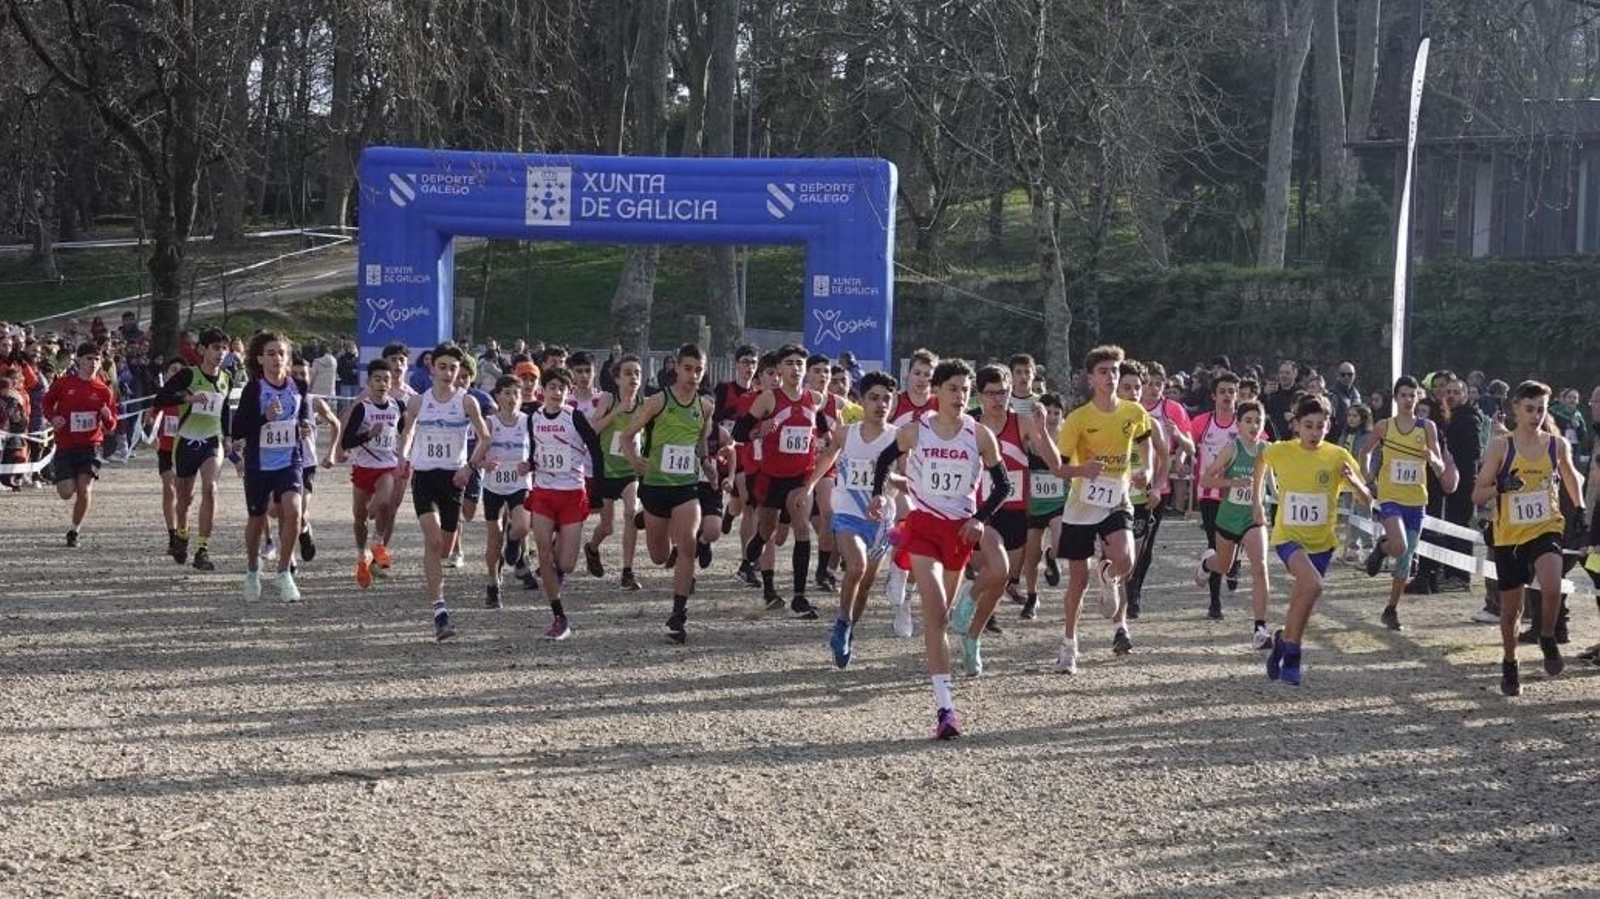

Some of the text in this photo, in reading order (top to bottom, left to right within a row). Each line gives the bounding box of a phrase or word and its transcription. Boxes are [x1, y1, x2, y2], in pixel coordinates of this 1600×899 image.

[421, 174, 476, 185] DEPORTE
[582, 173, 666, 194] XUNTA
[421, 185, 470, 196] GALEGO
[800, 183, 855, 193] DEPORTE
[799, 194, 849, 204] GALEGO
[581, 198, 718, 221] DE GALICIA
[384, 275, 395, 283] DE
[832, 277, 862, 285] XUNTA
[536, 425, 566, 433] TREGA
[266, 430, 289, 445] 844
[786, 436, 809, 450] 685
[427, 444, 451, 458] 881
[922, 448, 970, 461] TREGA
[669, 455, 691, 470] 148
[495, 470, 518, 483] 880
[931, 472, 963, 492] 937
[1396, 468, 1417, 482] 104
[1035, 482, 1057, 496] 909
[1088, 484, 1114, 504] 271
[1290, 504, 1319, 522] 105
[1516, 502, 1543, 521] 103
